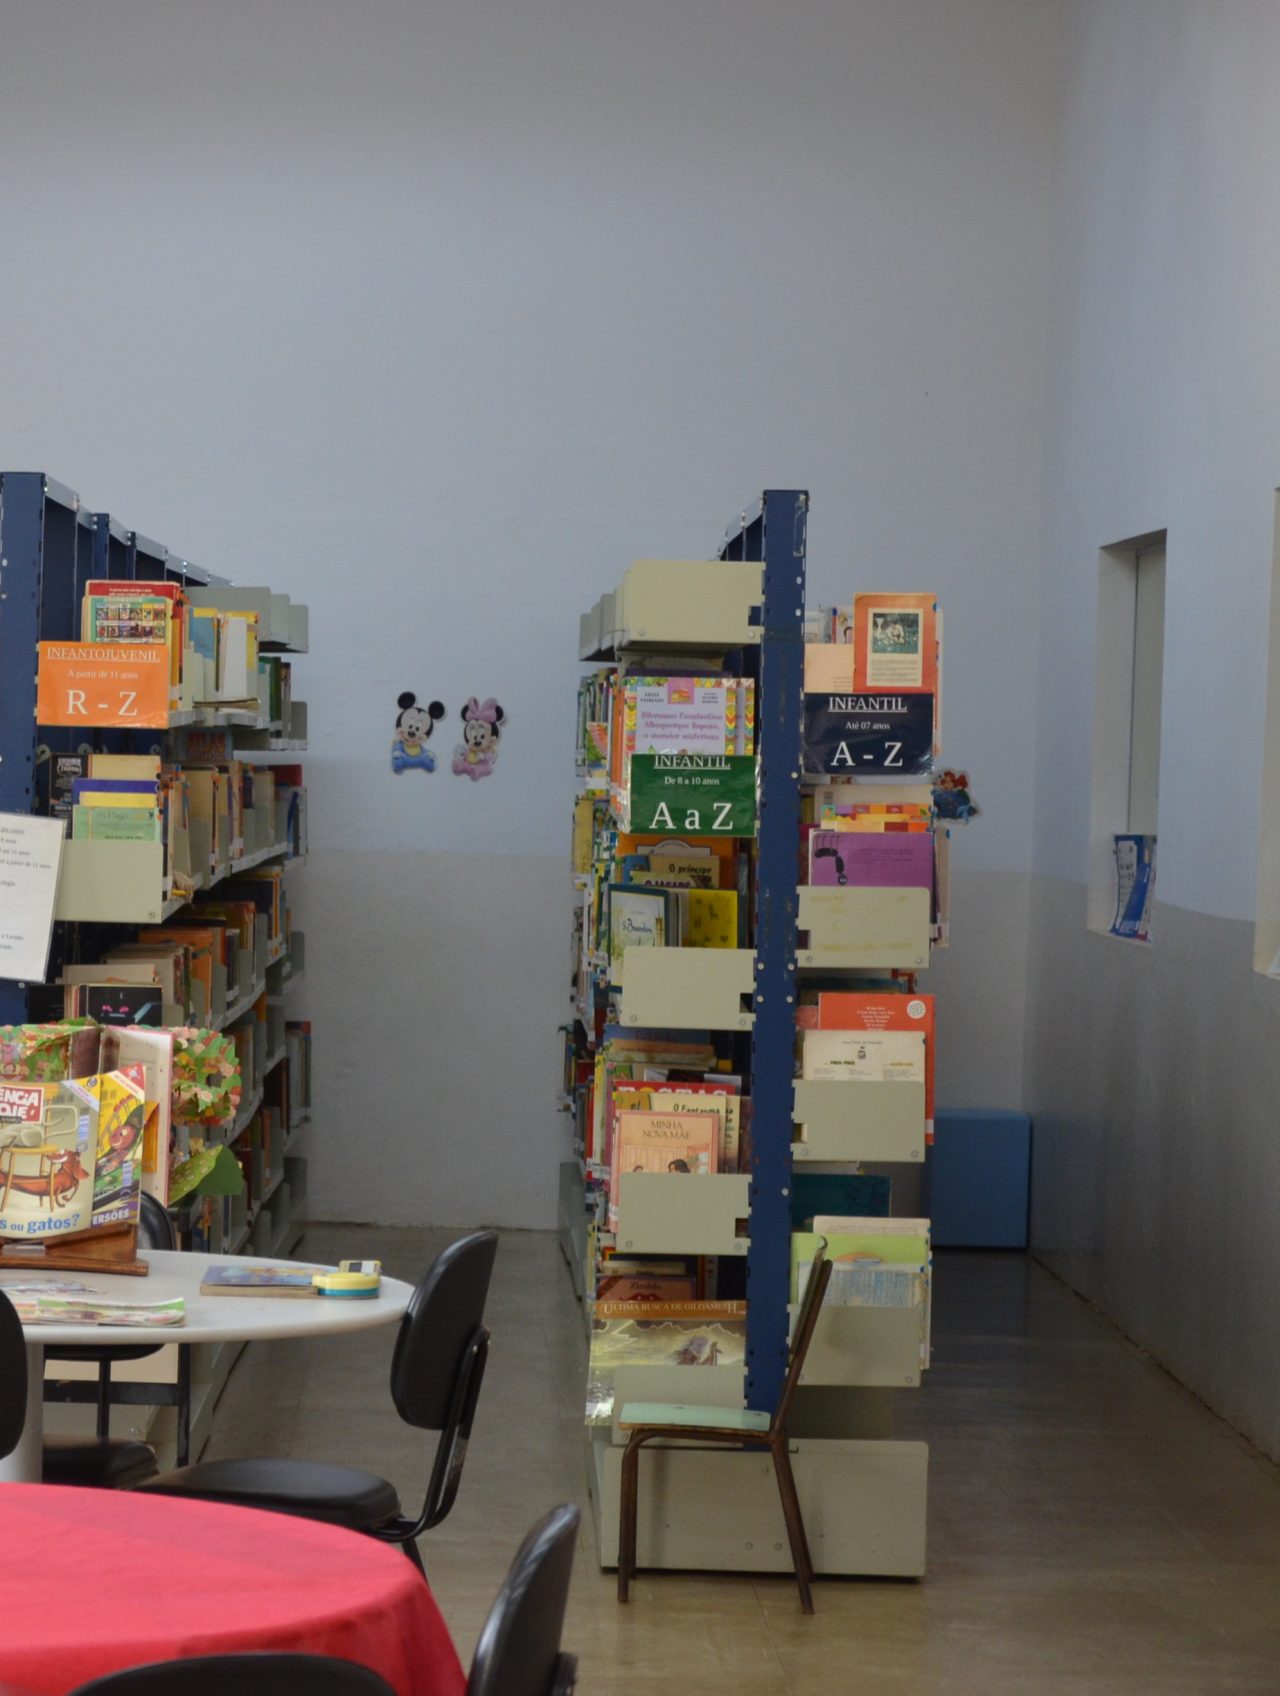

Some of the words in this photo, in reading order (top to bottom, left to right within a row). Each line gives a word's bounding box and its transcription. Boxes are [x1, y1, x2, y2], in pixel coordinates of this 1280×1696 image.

[47, 646, 160, 663] INFANTOJUVENIL
[68, 670, 76, 678] A
[76, 670, 96, 680] partir
[98, 670, 108, 678] de
[110, 671, 118, 679] 11
[66, 689, 89, 715] R
[118, 691, 138, 716] Z
[828, 696, 908, 713] INFANTIL
[845, 721, 860, 730] Até
[860, 722, 870, 730] 07
[872, 722, 890, 730] anos
[830, 741, 856, 766] A
[884, 742, 903, 766] Z
[654, 755, 731, 770] INFANTIL
[664, 776, 675, 785] De
[677, 776, 683, 785] 8
[692, 777, 700, 785] 10
[649, 801, 678, 830] A
[685, 809, 702, 830] a
[712, 802, 734, 830] Z
[678, 864, 712, 874] príncipe
[650, 1120, 684, 1129] MINHA
[642, 1129, 668, 1138] NOVA
[10, 1222, 24, 1232] ou
[26, 1214, 81, 1234] gatos?
[92, 1208, 130, 1226] ERSÕES
[642, 1302, 668, 1311] BUSCA
[671, 1302, 682, 1311] DE
